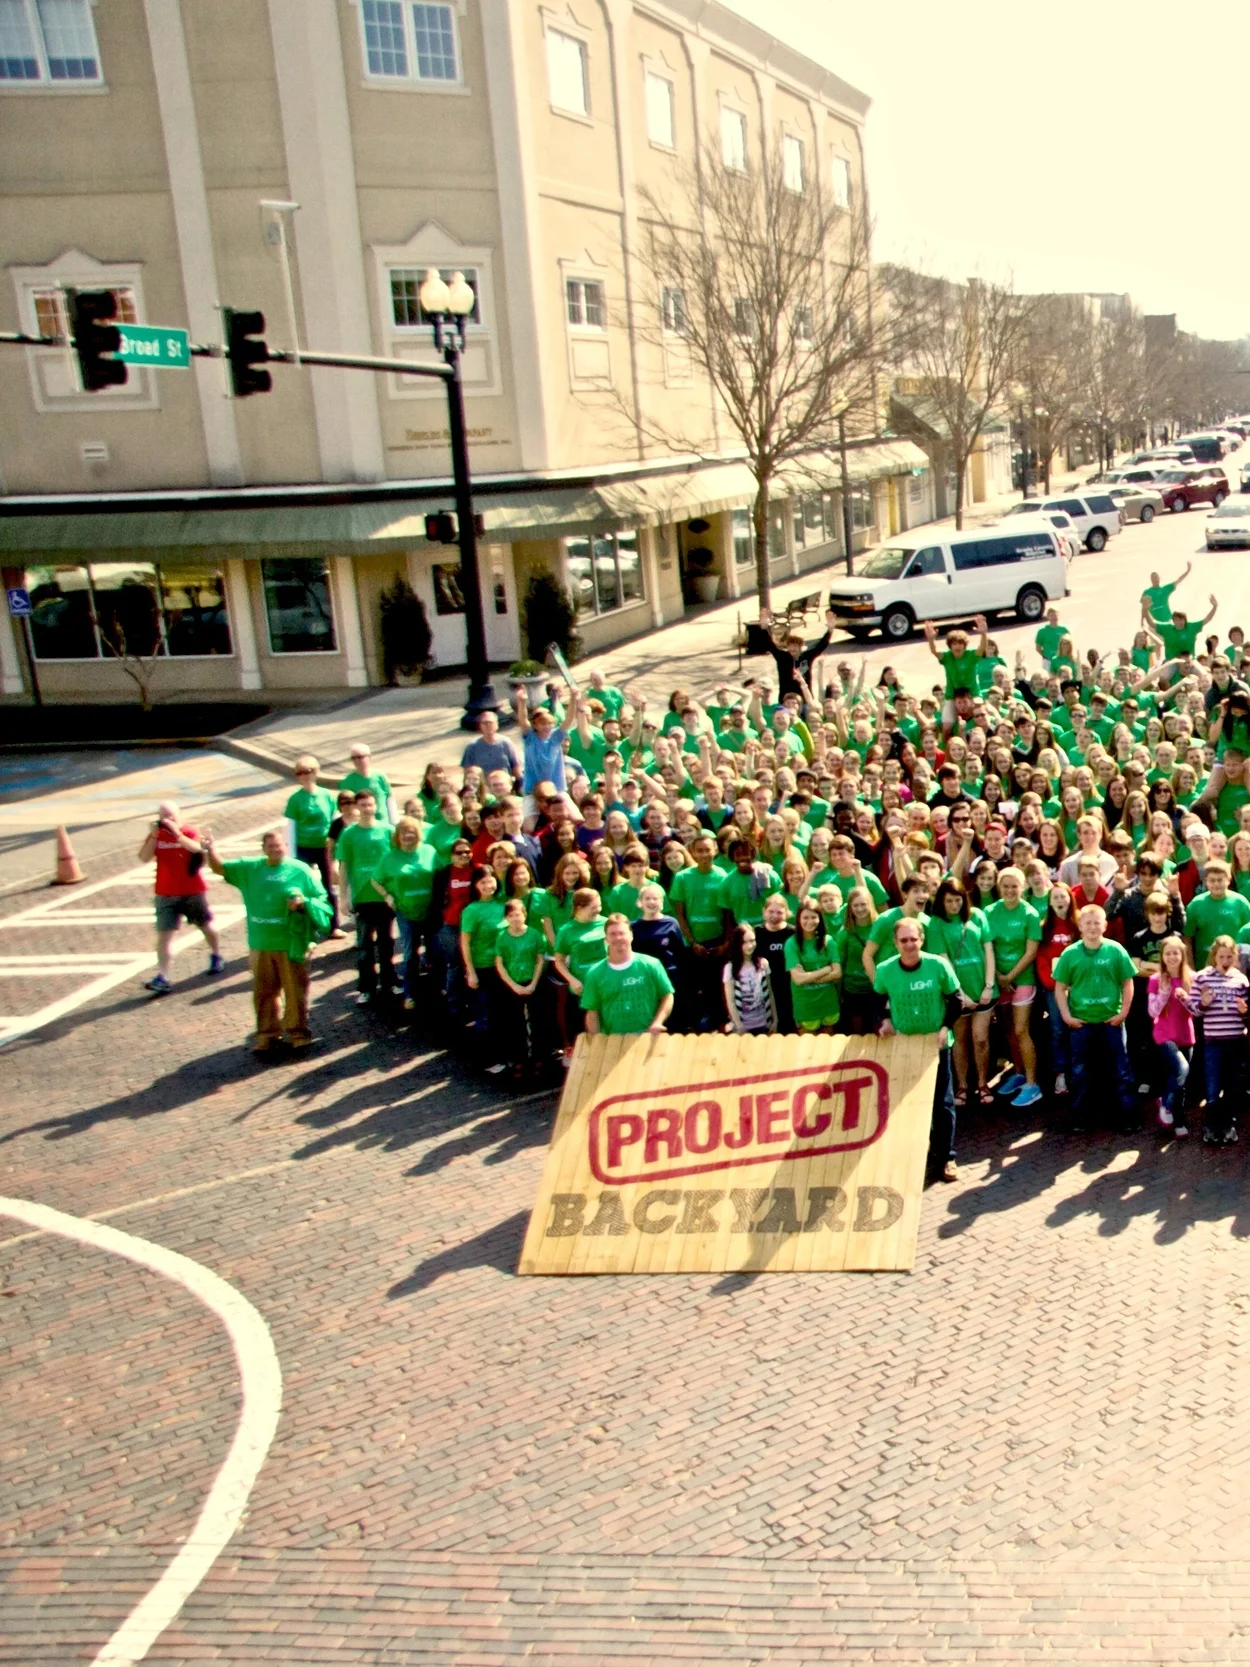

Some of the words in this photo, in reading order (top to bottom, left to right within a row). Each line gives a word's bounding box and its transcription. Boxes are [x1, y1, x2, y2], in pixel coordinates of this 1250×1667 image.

[119, 333, 160, 357] Broad
[166, 338, 182, 357] St
[910, 979, 933, 991] LIGHT
[606, 1075, 873, 1169] PROJECT
[546, 1185, 904, 1238] BACKYARD
